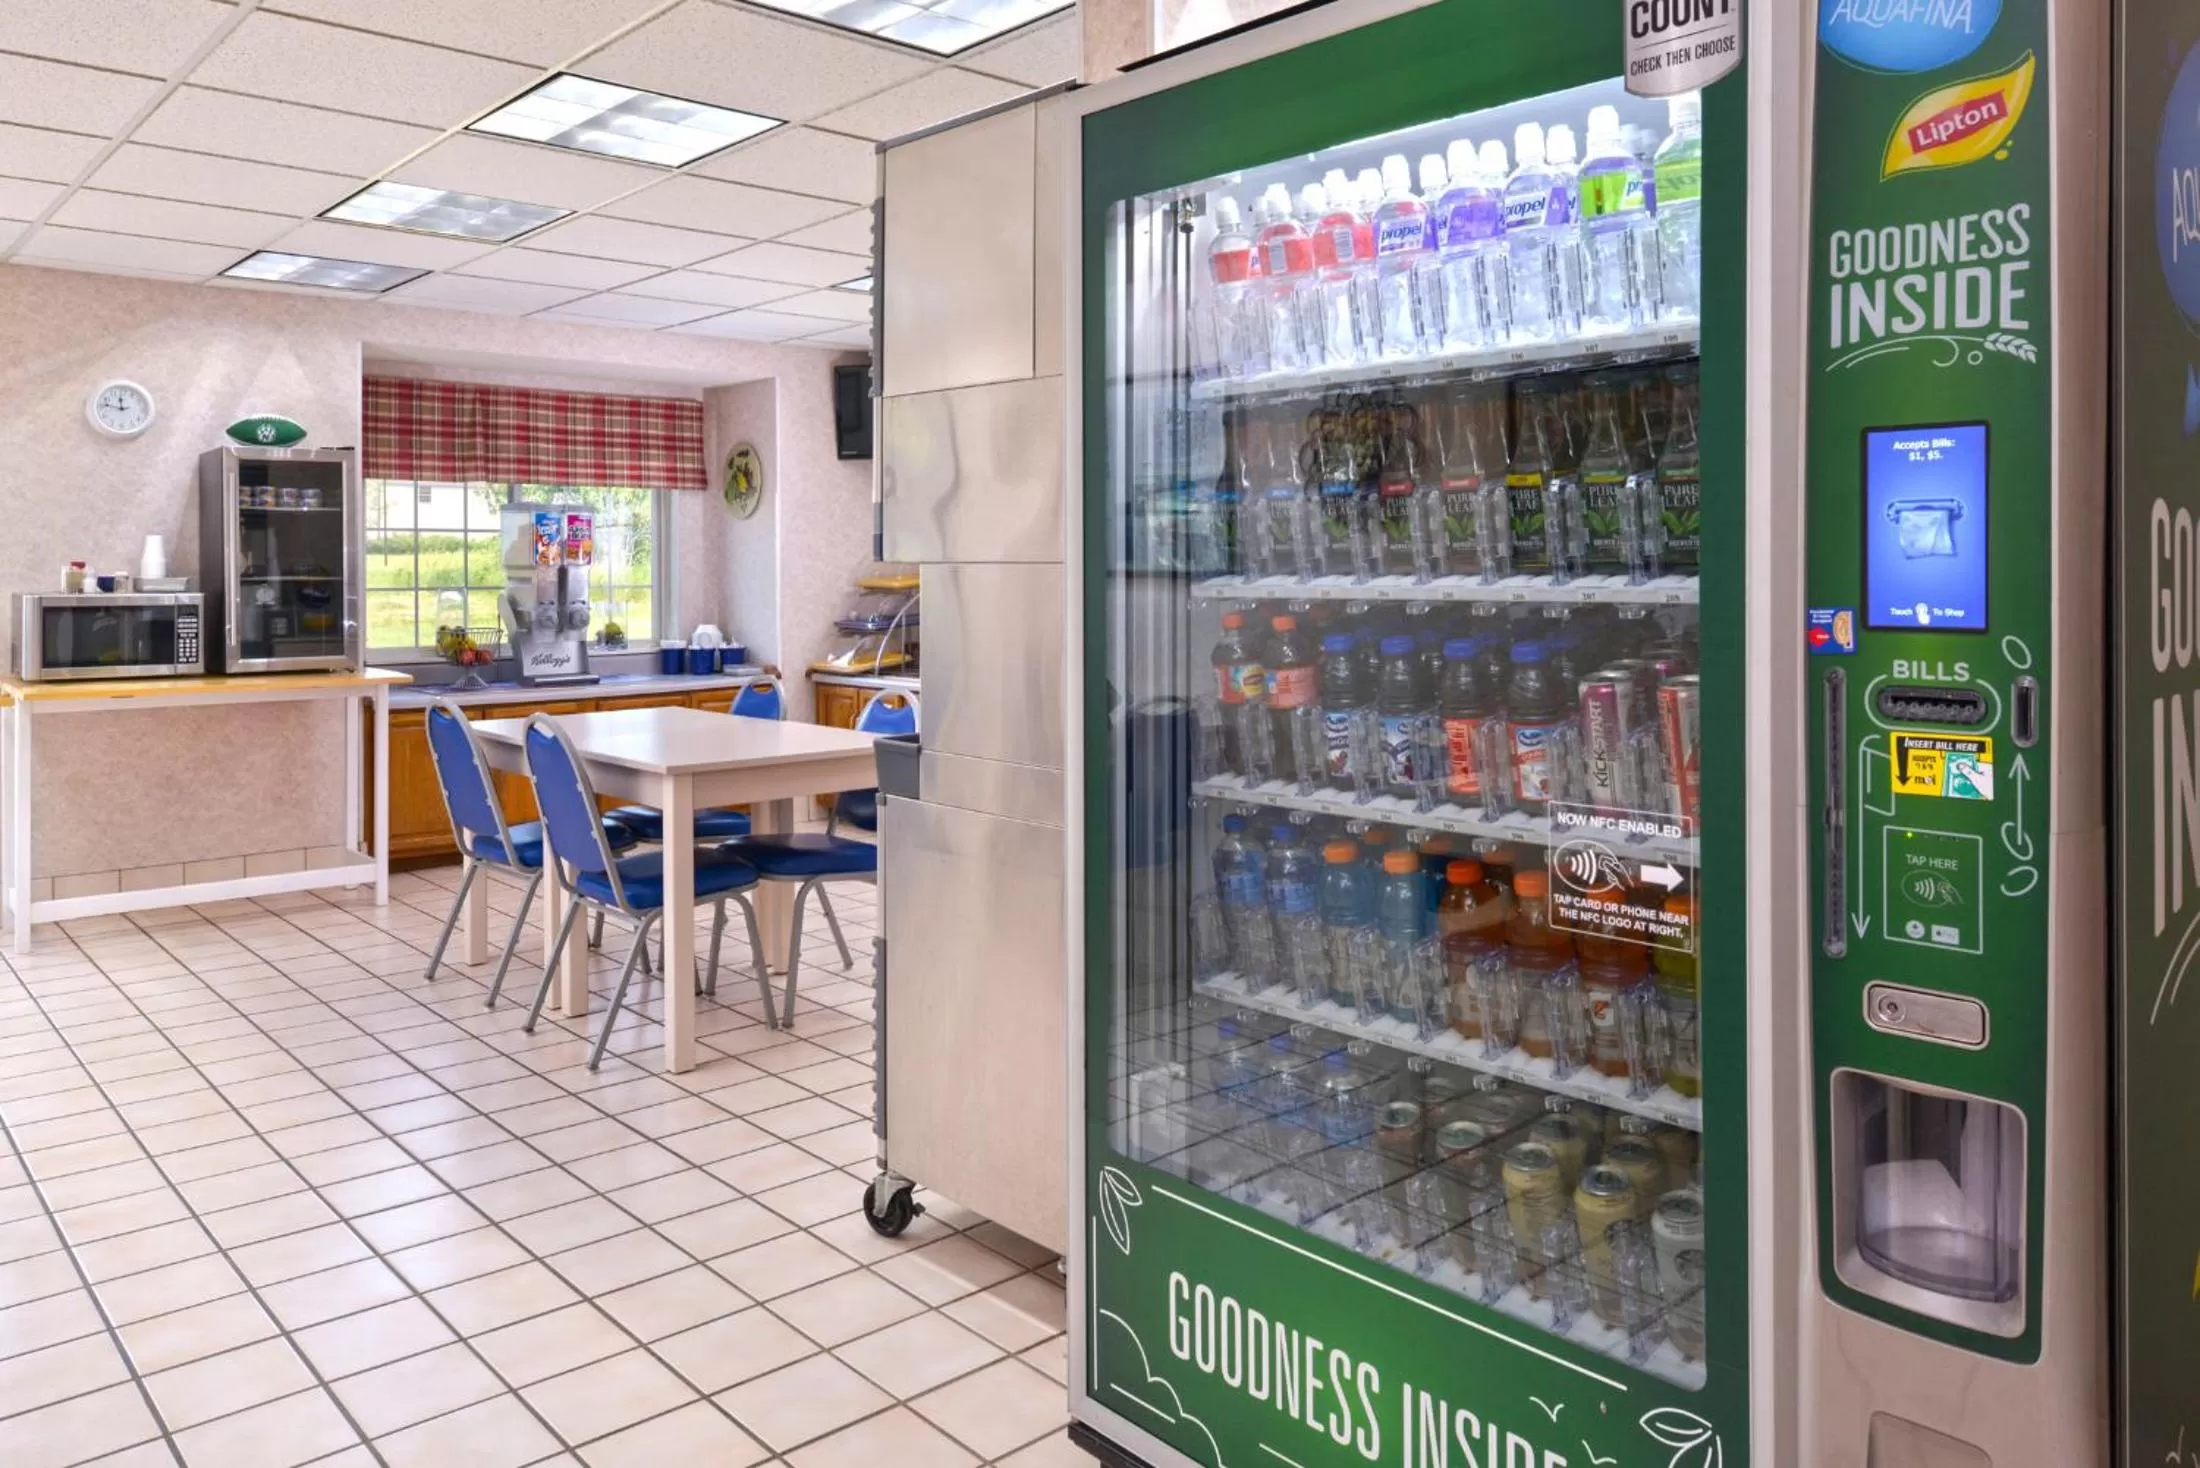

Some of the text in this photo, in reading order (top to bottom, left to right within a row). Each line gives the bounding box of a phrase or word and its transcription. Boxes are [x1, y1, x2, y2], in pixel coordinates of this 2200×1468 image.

[1630, 35, 1736, 76] CHECK THEN CHOOSE
[1916, 99, 1999, 147] Lipton
[1381, 223, 1422, 243] propel
[1829, 203, 2031, 278] GOODNESS
[1830, 260, 2030, 349] INSIDE
[1893, 440, 1930, 450] Accepts
[1890, 607, 1965, 618] Touch To Shop
[530, 652, 572, 668] Kellogg's
[1892, 659, 1970, 683] BILLS
[1904, 736, 1979, 752] INSERT BILL HERE
[1557, 812, 1682, 839] NOW NFC ENABLED
[1905, 853, 1959, 872] TAP HERE
[1554, 893, 1689, 926] TAP CARD OR PHONE NEAR
[1559, 907, 1684, 938] THE NFC LOGO AT RIGHT.
[1168, 1270, 1381, 1462] GOODNESS
